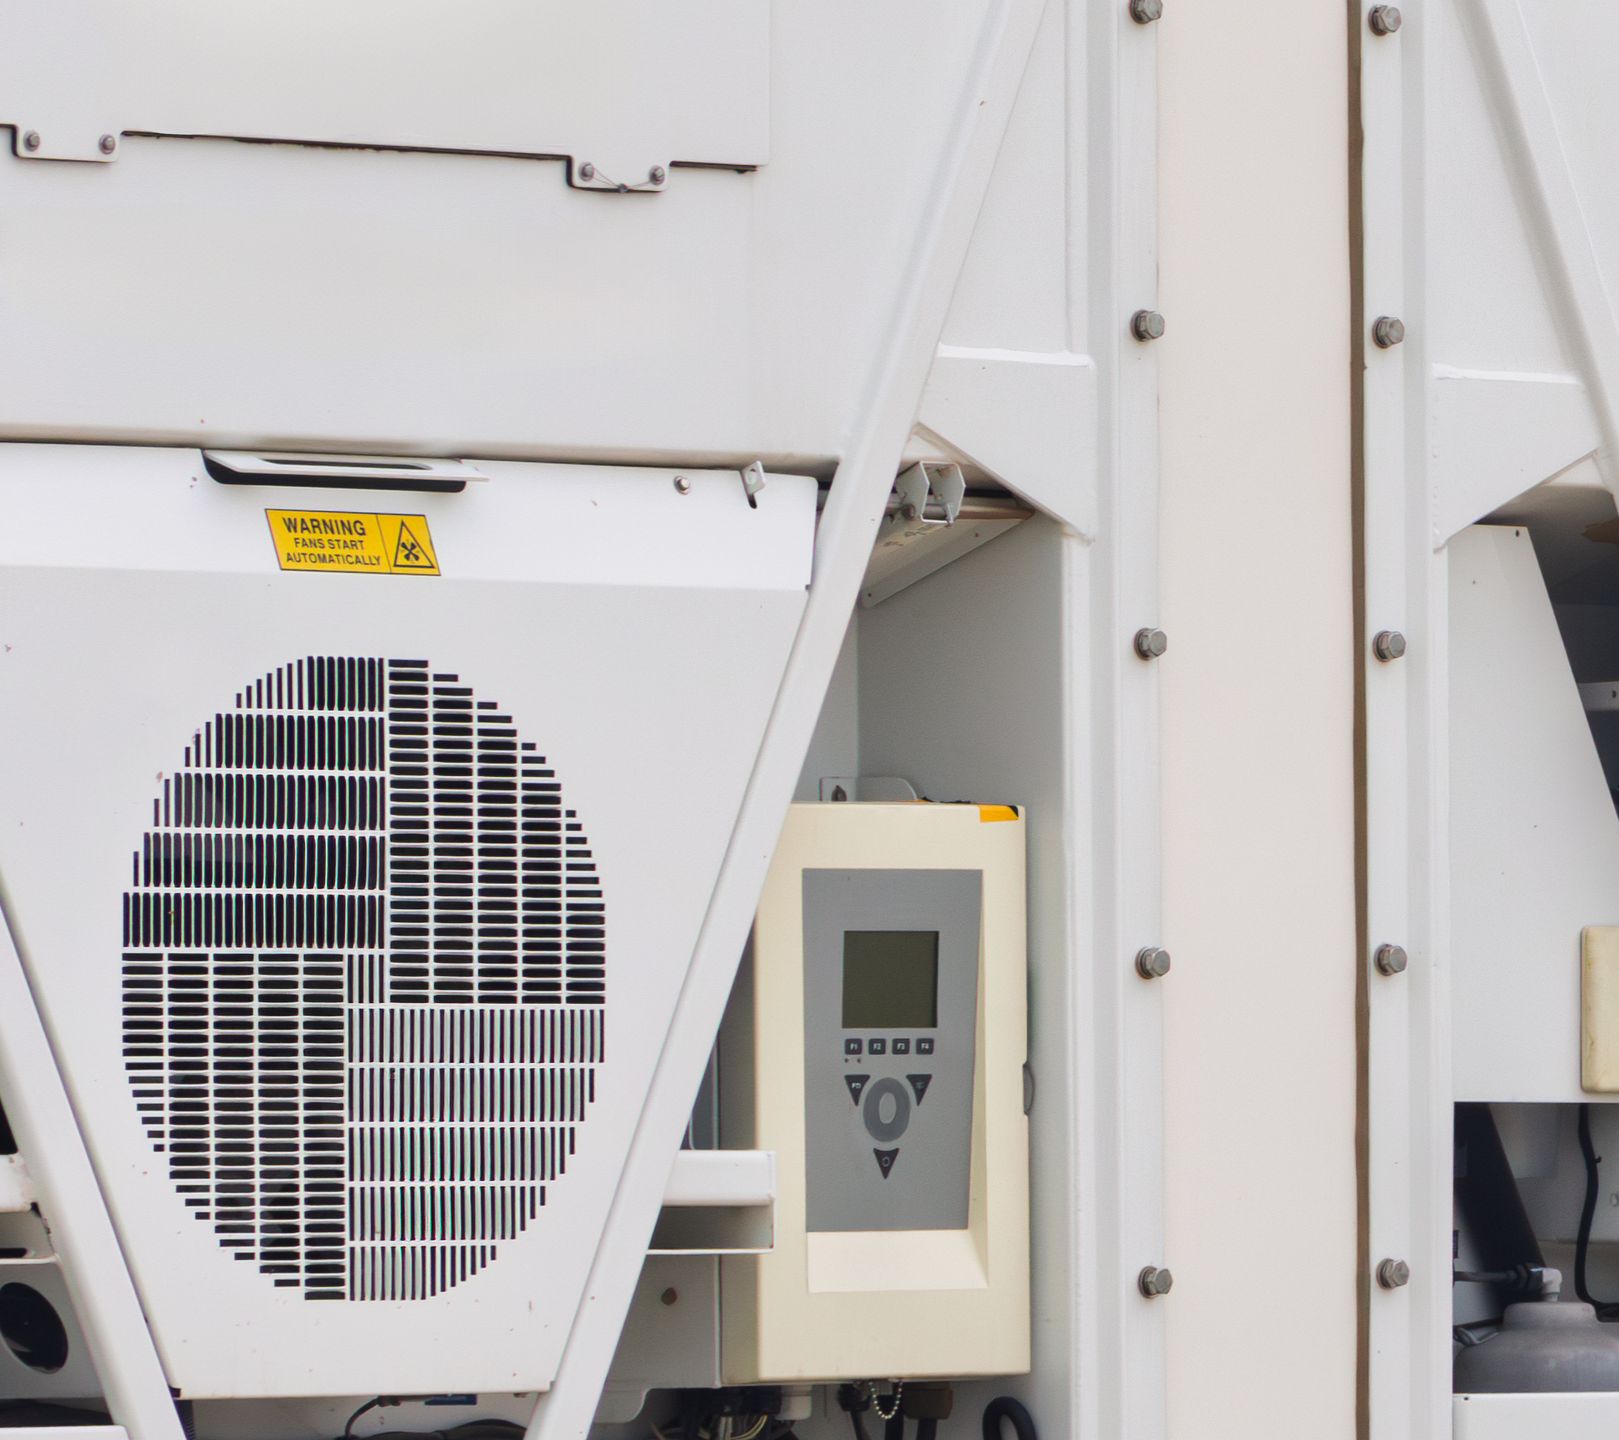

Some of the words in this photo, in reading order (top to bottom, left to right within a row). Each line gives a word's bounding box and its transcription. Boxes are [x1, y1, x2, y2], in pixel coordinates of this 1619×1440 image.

[282, 517, 366, 536] WARNING
[294, 537, 325, 549] FANS
[327, 539, 364, 551] START
[286, 552, 381, 566] AUTOMATICALLY
